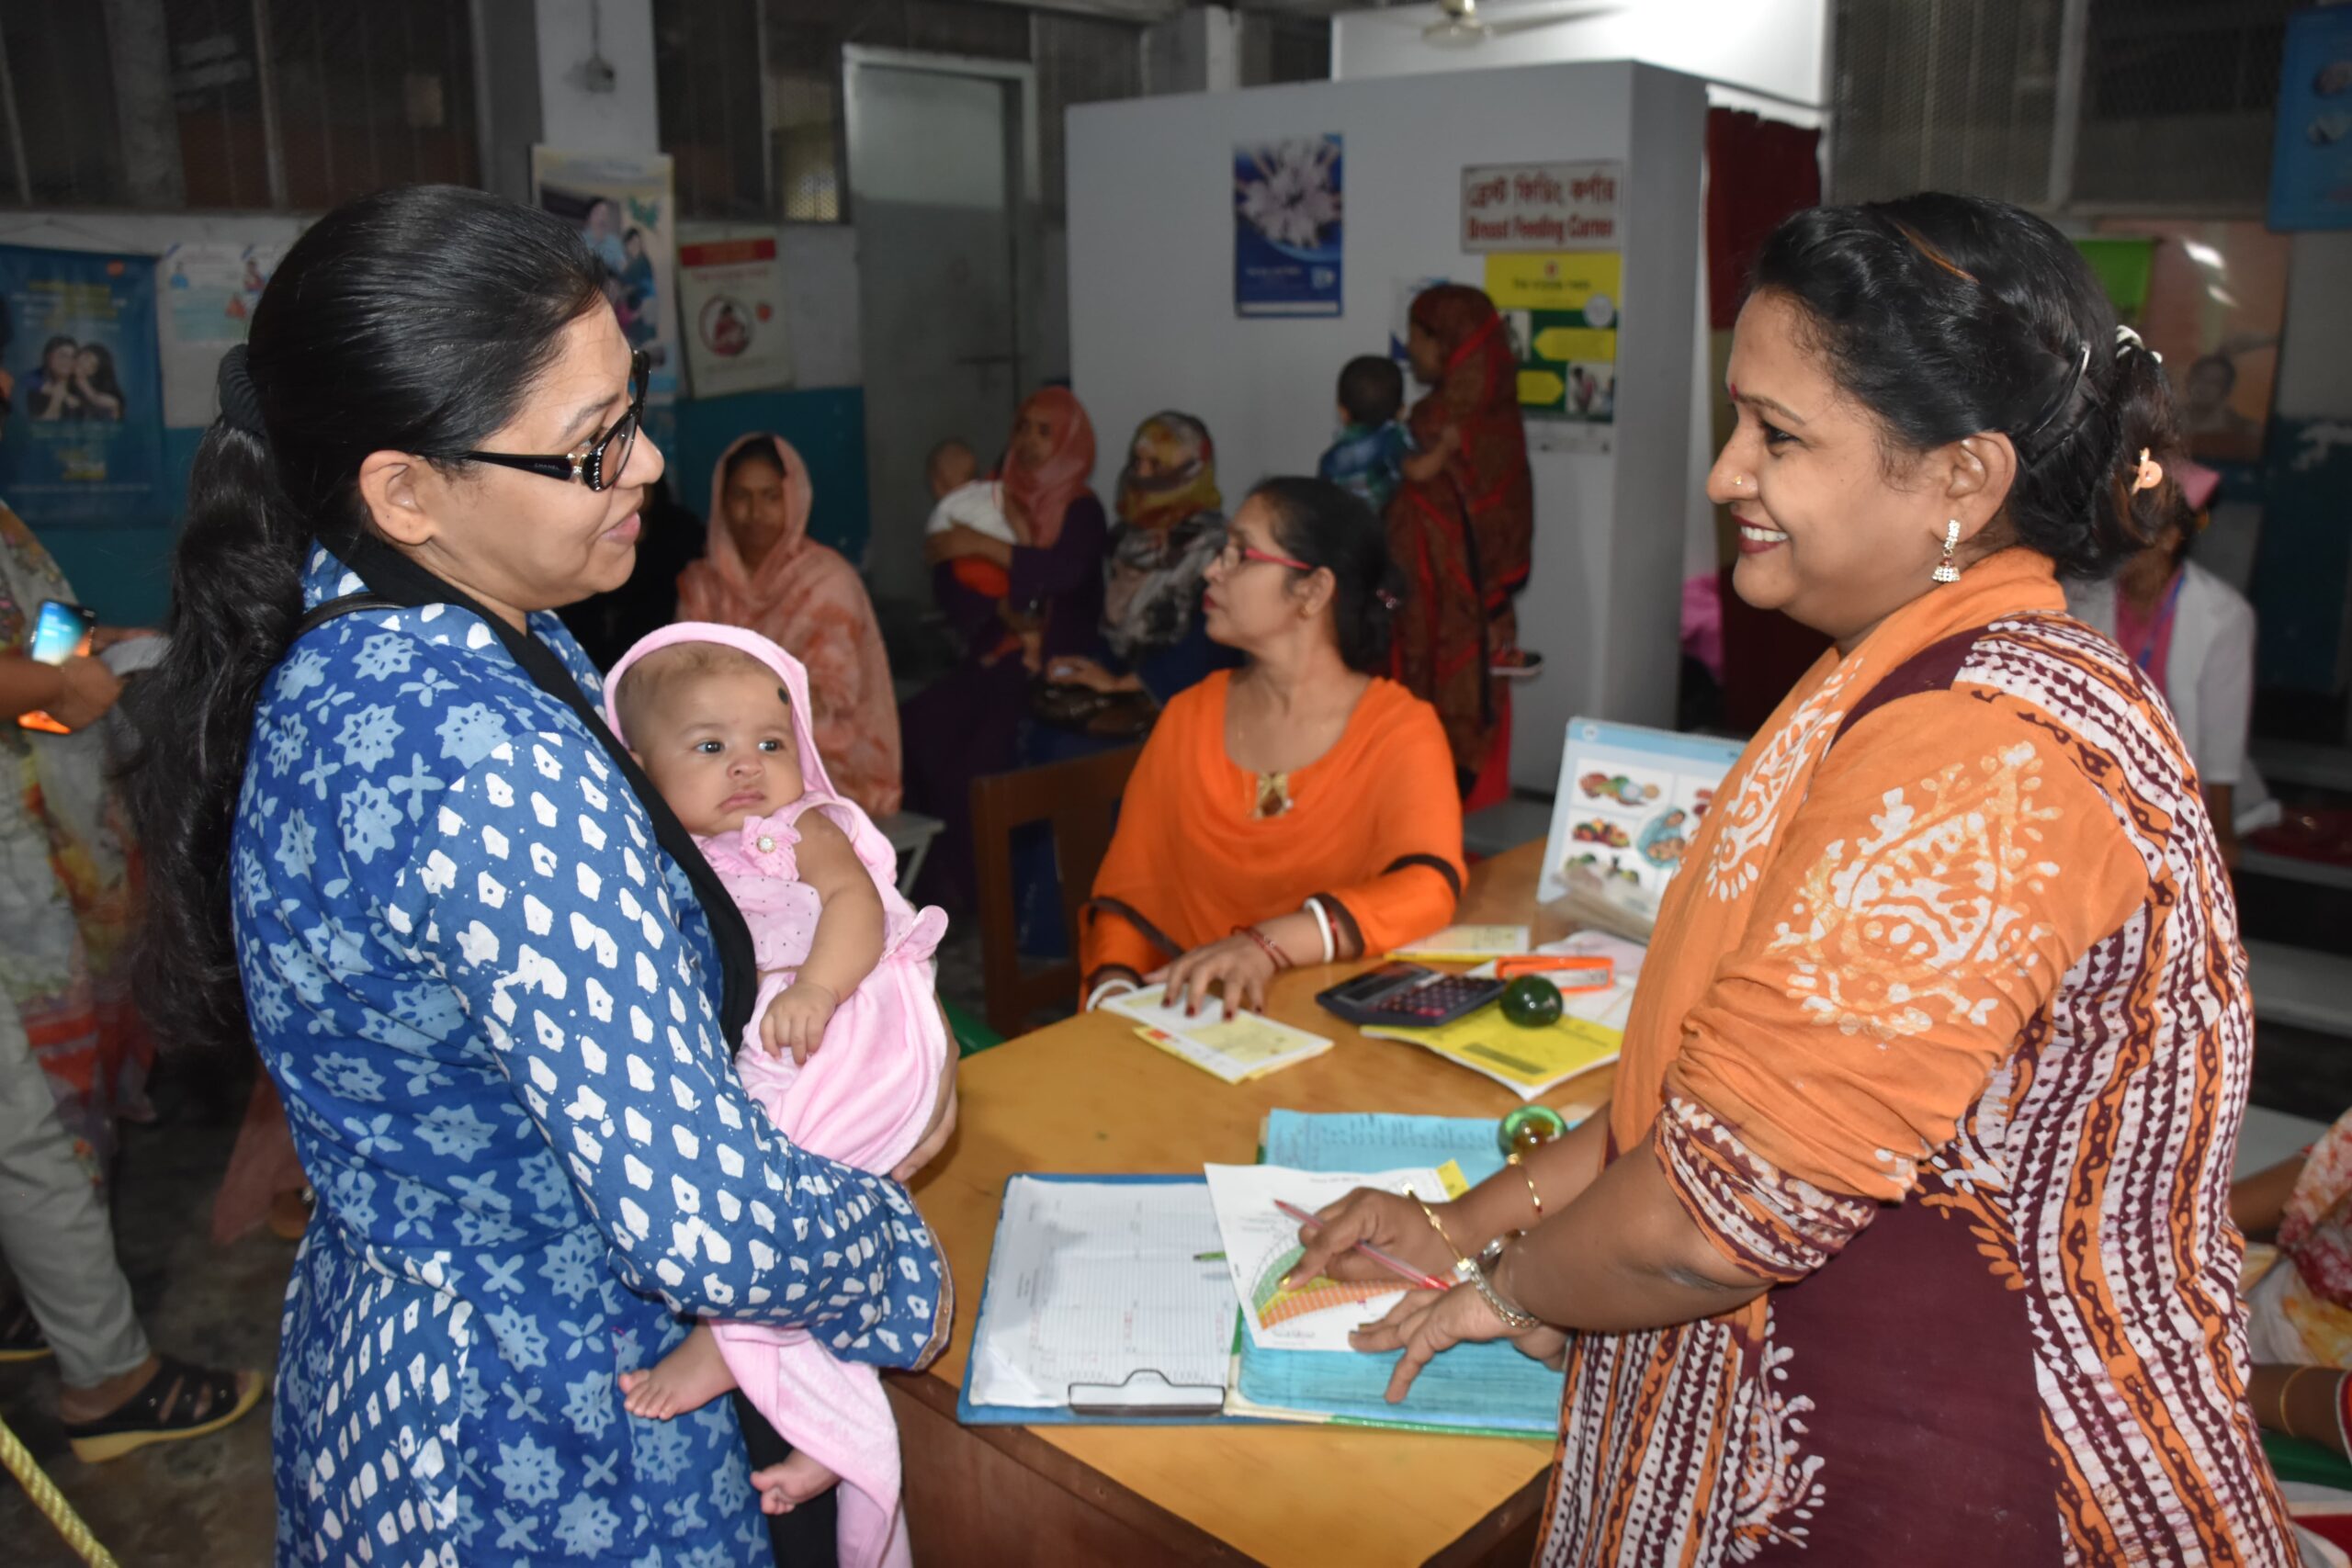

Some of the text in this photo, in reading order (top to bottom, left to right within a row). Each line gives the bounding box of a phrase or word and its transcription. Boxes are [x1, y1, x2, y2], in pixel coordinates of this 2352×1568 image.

[1467, 212, 1613, 245] Breast Feeding Corner
